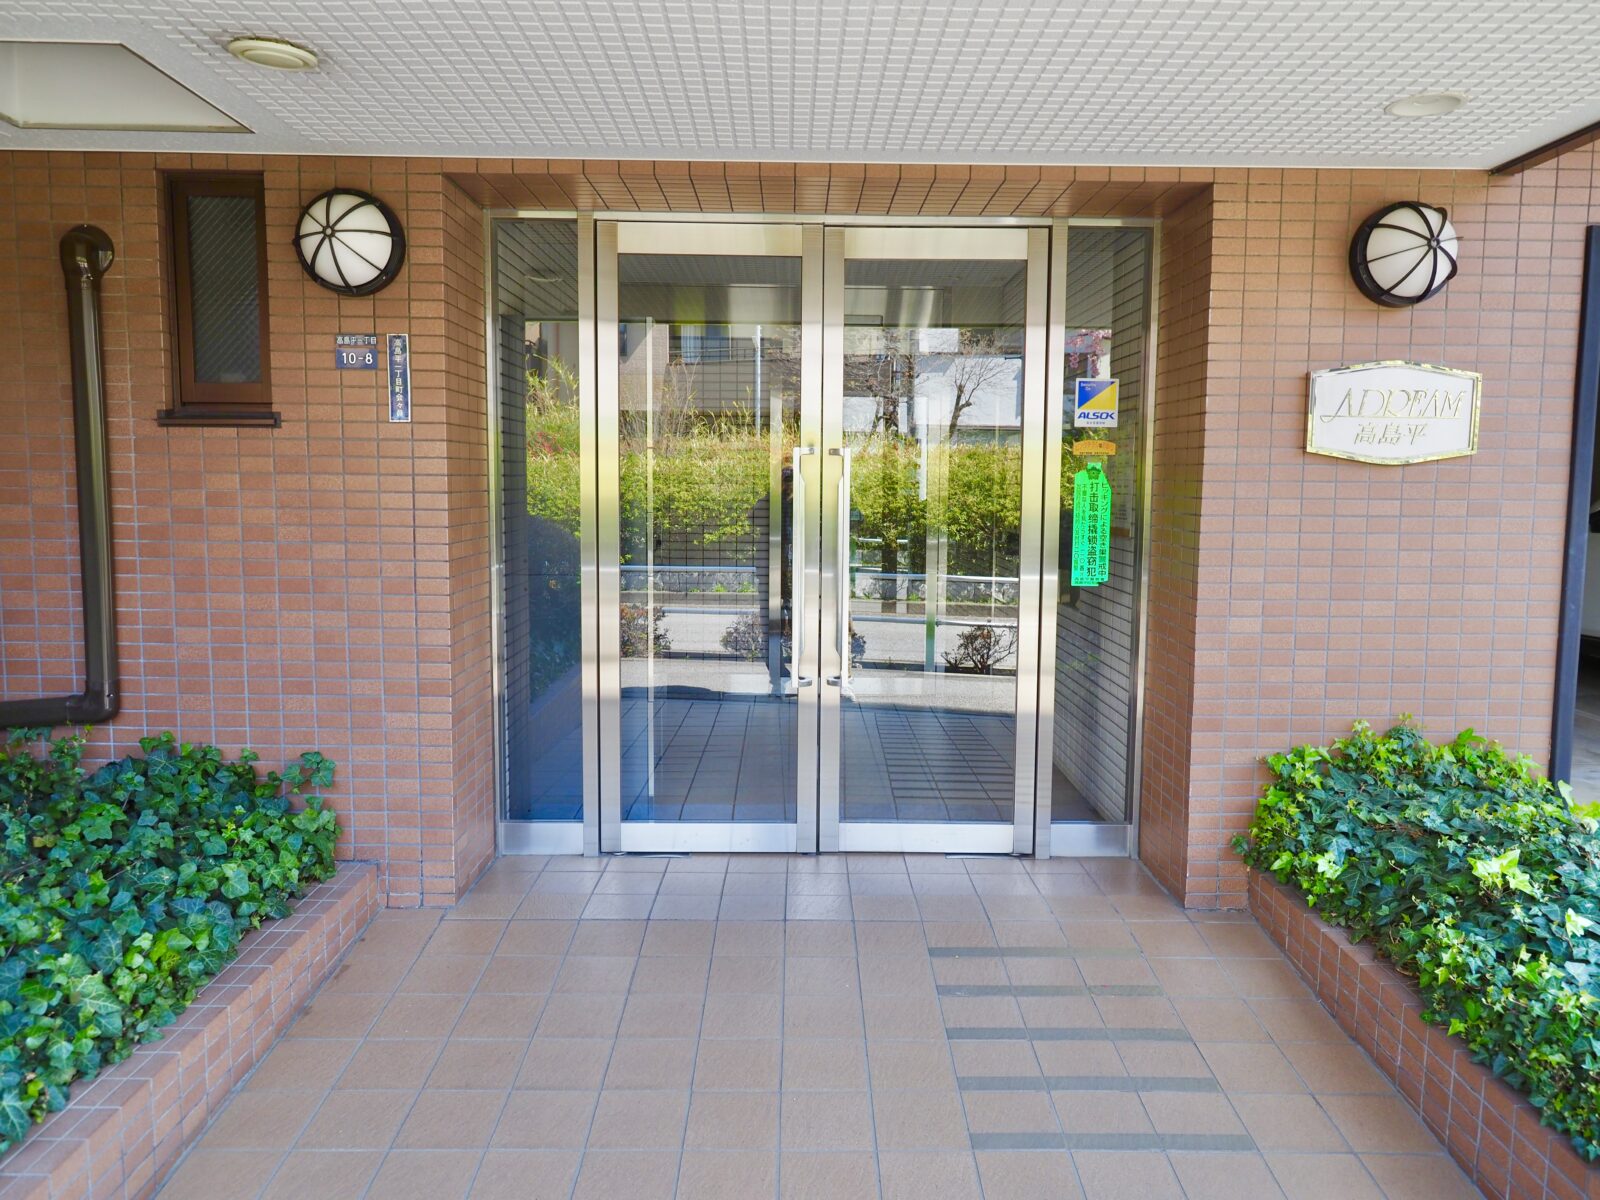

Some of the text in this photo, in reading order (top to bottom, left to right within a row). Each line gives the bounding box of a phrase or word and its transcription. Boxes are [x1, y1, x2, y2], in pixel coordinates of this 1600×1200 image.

[342, 352, 373, 364] 10-8
[1320, 387, 1468, 423] ADREAM
[1077, 411, 1115, 420] ALSOK
[1353, 422, 1428, 446] 高島平
